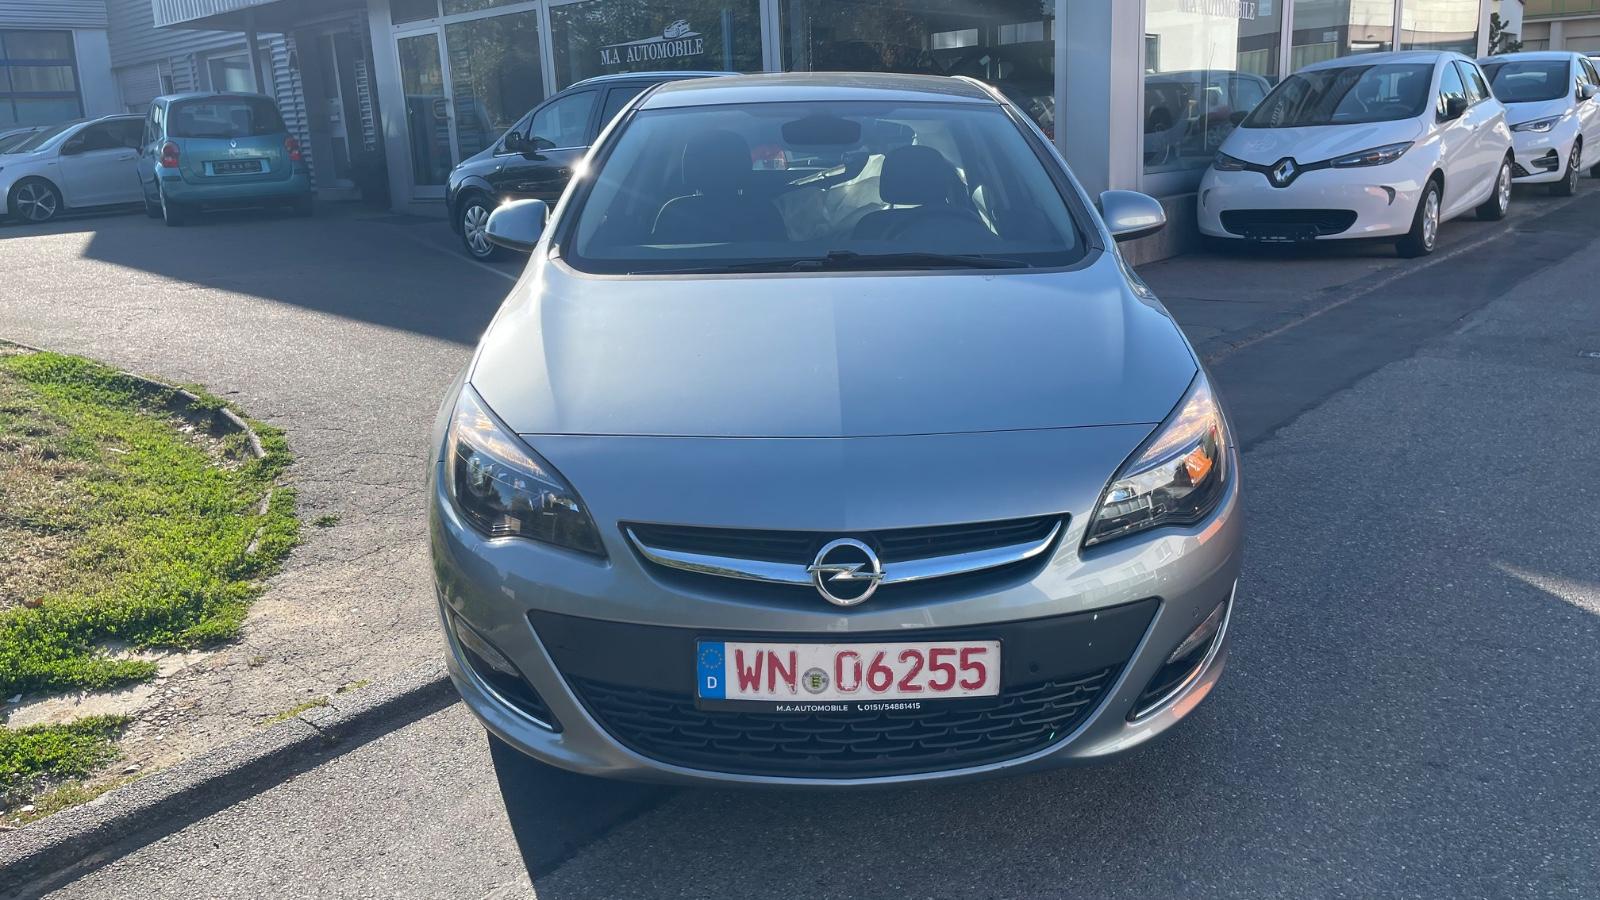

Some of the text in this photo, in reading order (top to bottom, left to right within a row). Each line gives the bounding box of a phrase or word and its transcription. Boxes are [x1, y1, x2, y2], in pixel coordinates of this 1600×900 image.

[600, 38, 704, 65] M.A AUTOMOBILE
[734, 647, 989, 694] WN 06255
[706, 676, 717, 689] D
[776, 704, 849, 712] M.A-AUTOMOBILE
